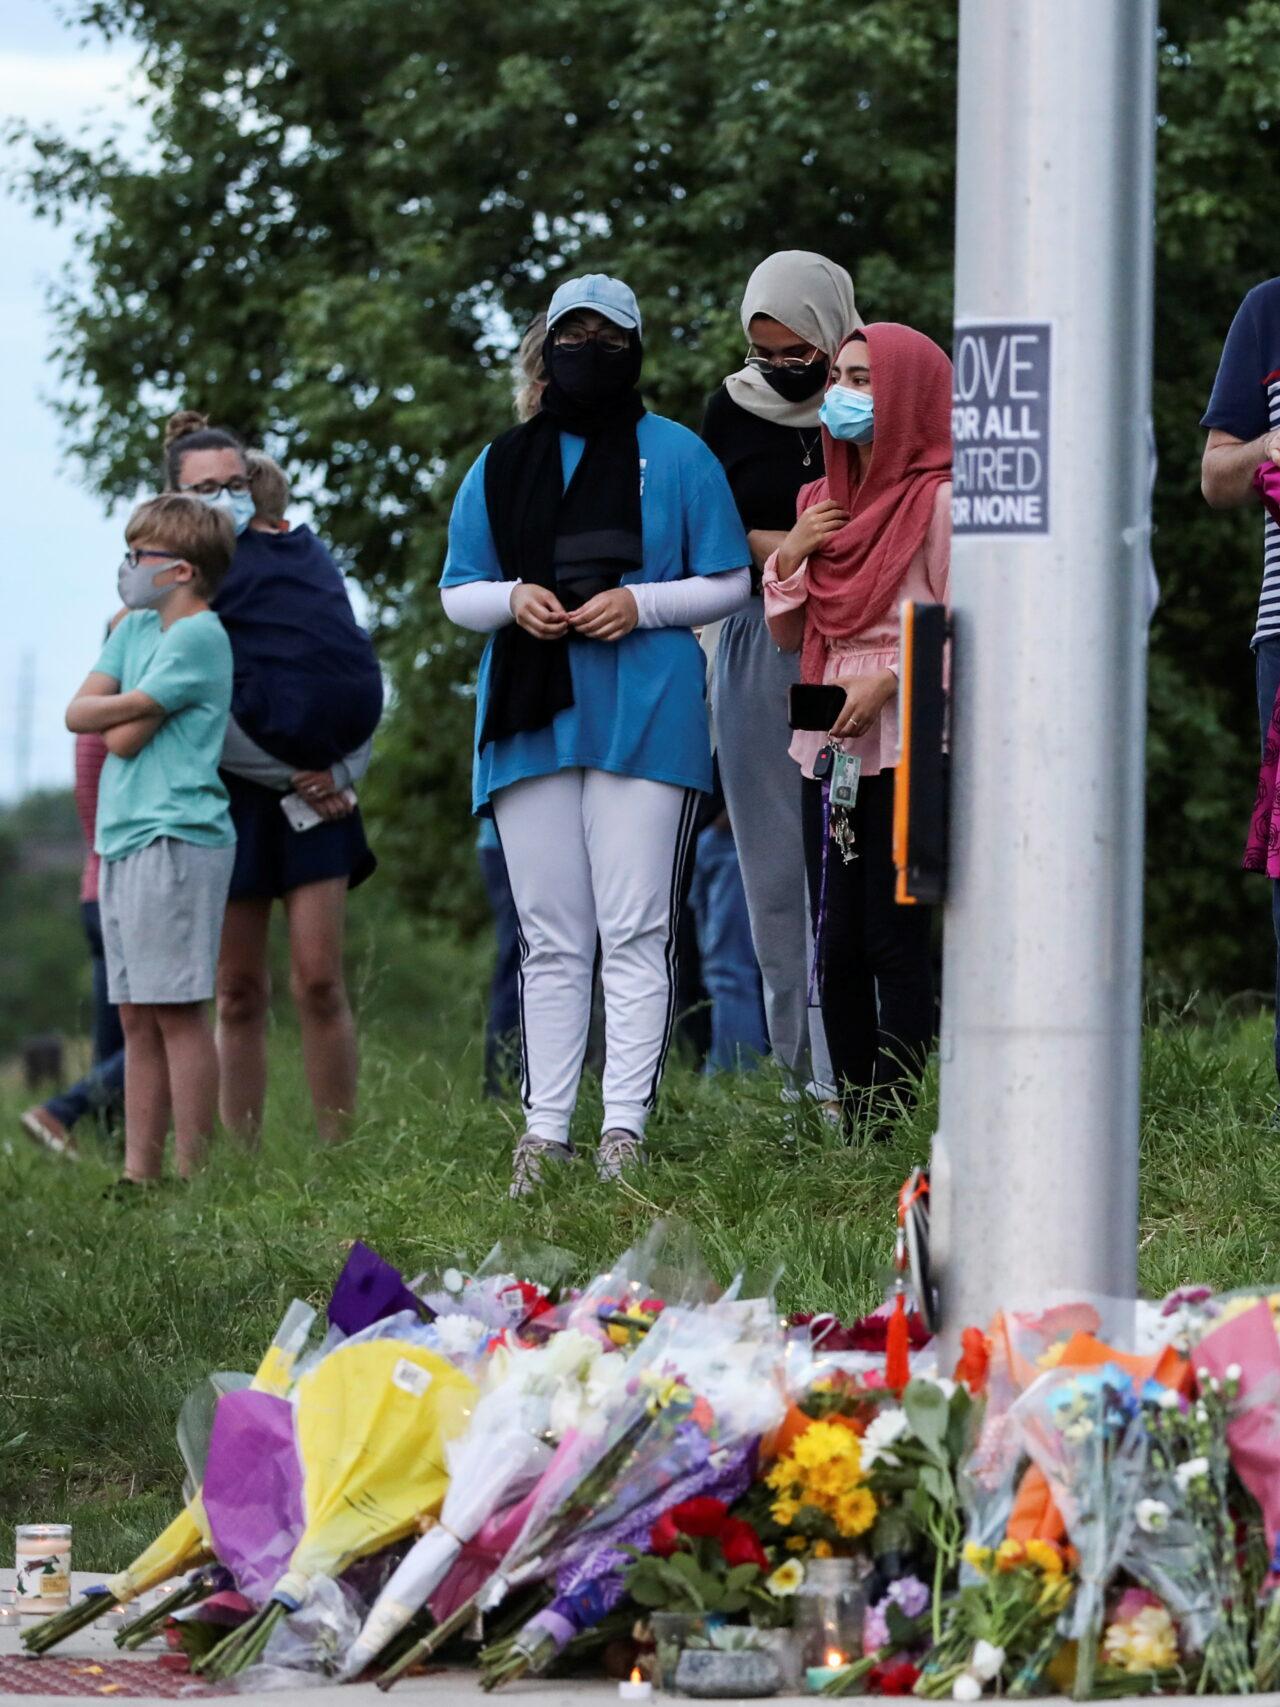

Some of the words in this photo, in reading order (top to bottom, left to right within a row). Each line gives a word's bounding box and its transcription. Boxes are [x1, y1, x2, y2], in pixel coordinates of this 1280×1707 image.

[983, 405, 1041, 440] ALL
[953, 446, 1043, 492] ATRED
[952, 496, 973, 526] OR
[973, 495, 1043, 525] NONE
